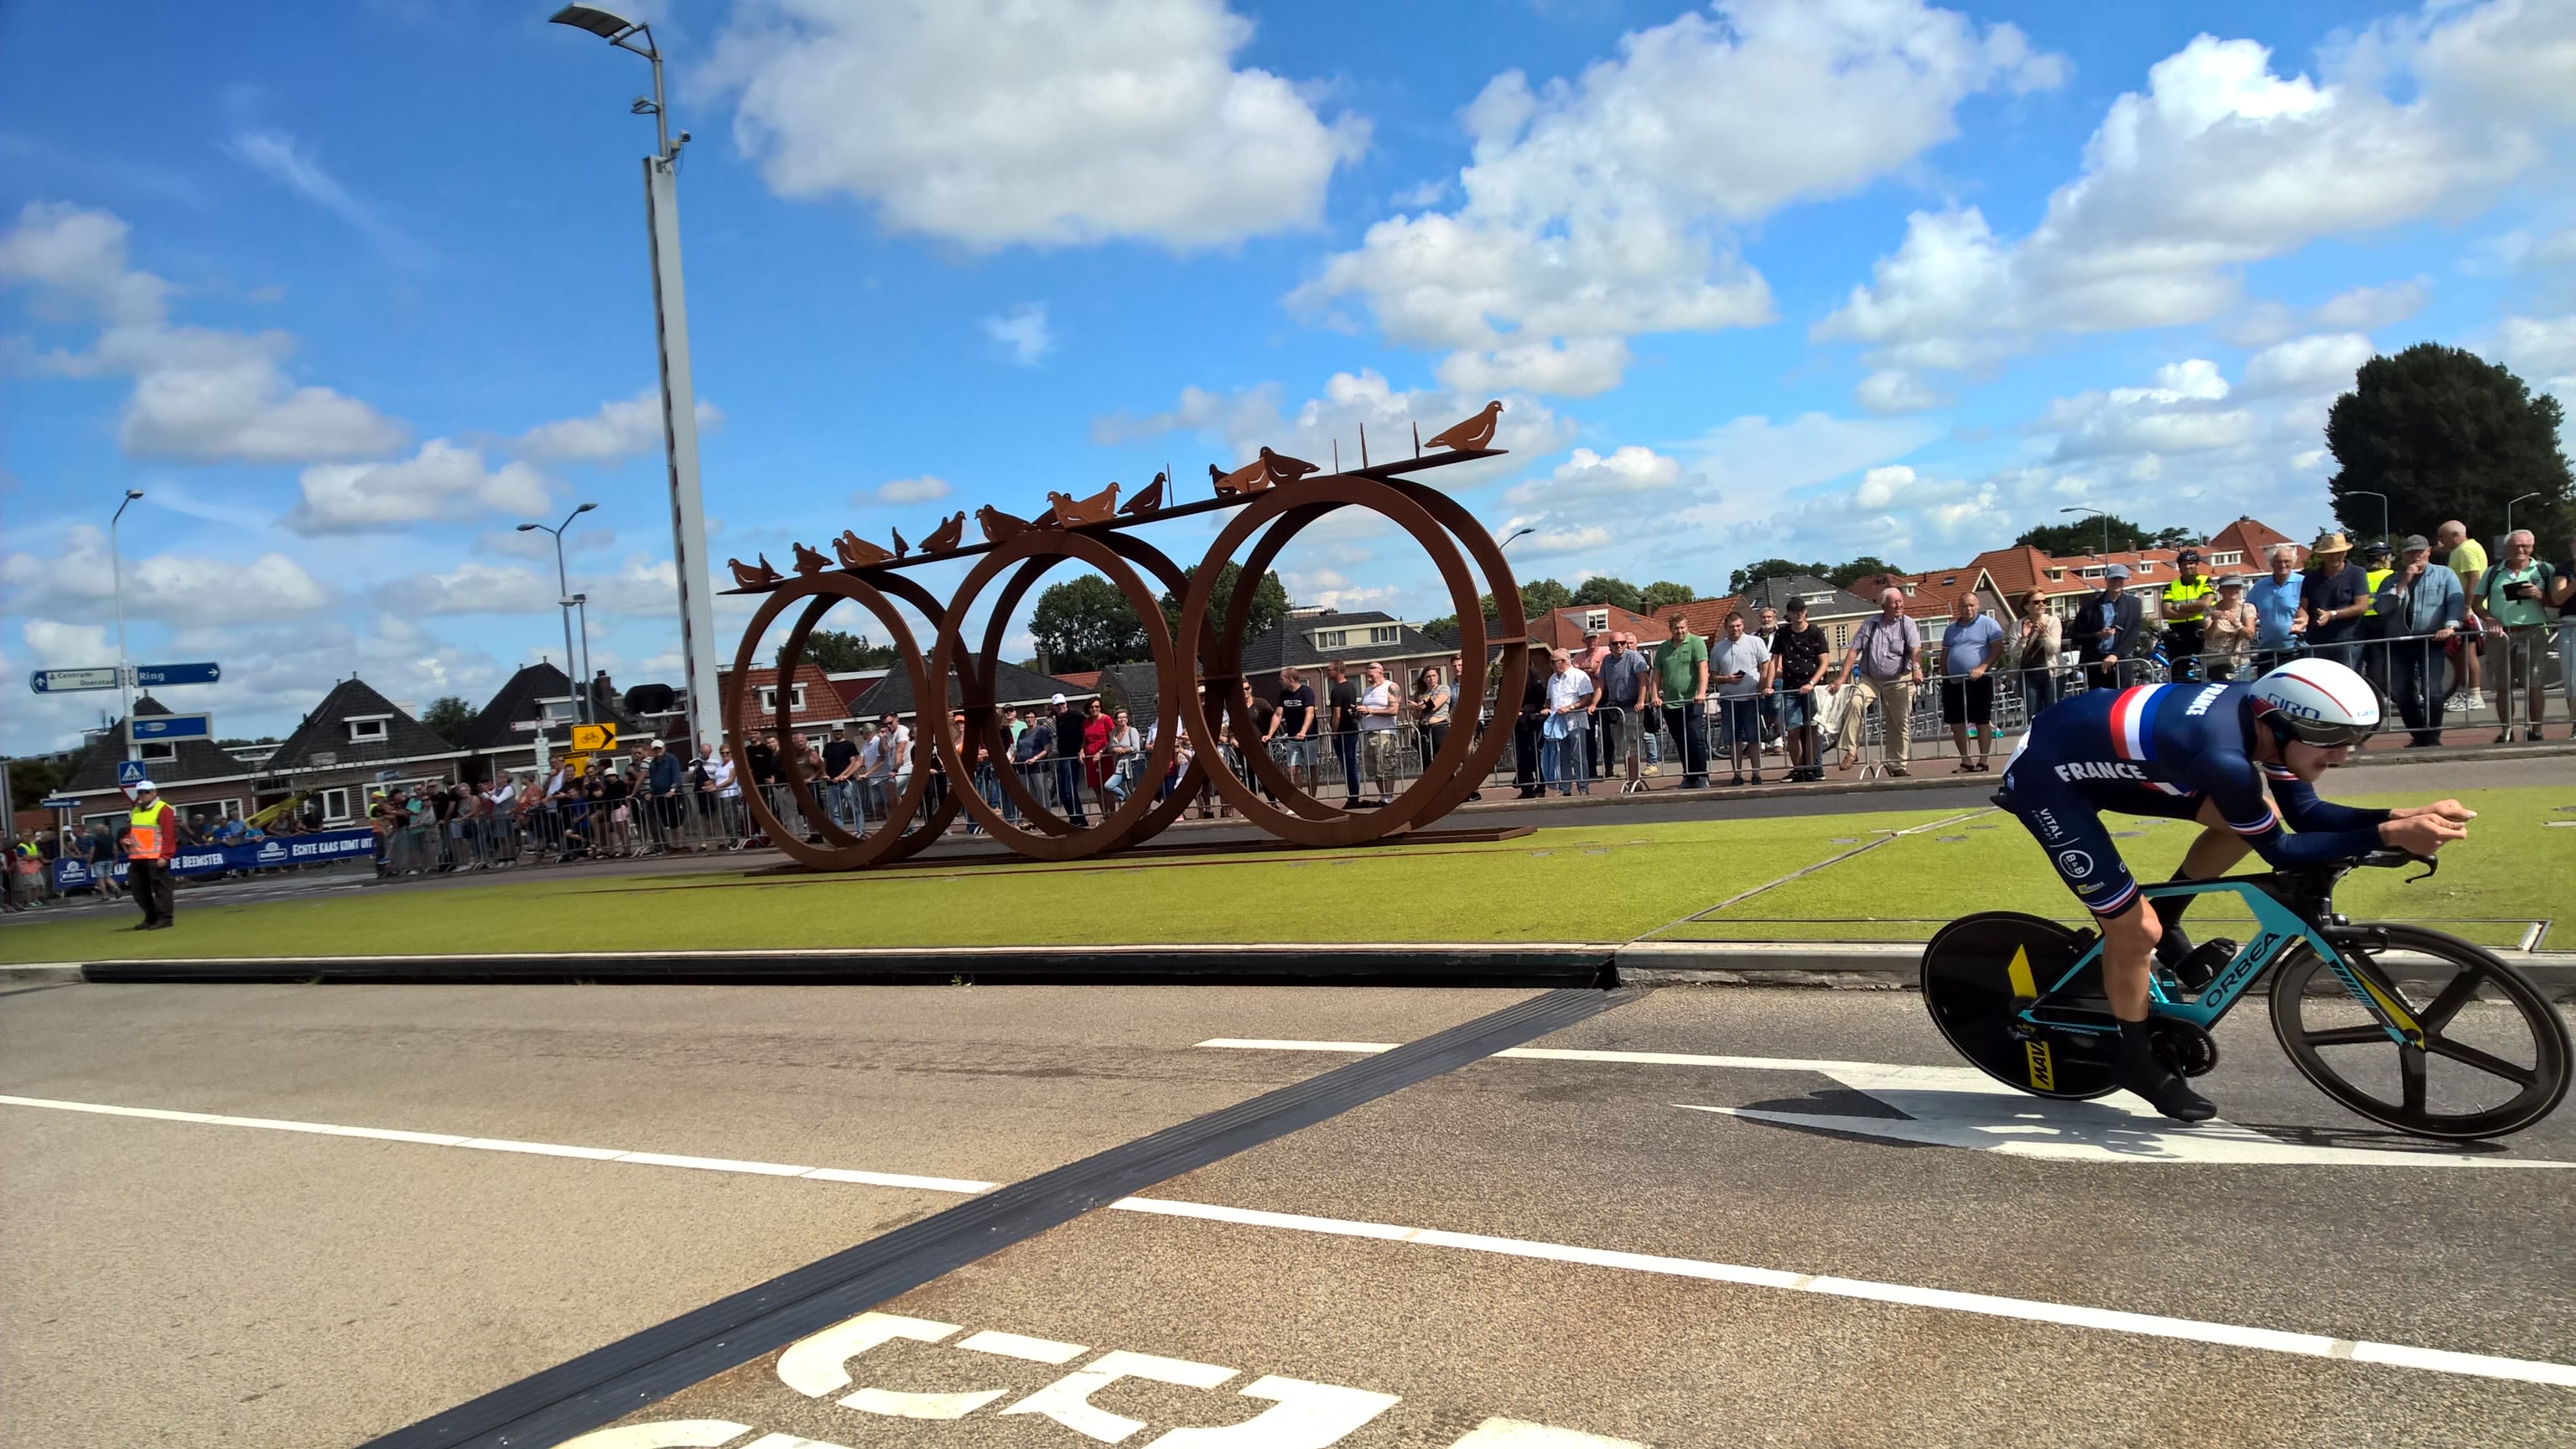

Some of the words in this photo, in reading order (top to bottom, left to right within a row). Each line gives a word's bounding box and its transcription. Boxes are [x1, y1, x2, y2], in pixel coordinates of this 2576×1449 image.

[139, 672, 164, 682] Ring
[2185, 683, 2230, 715] FRANCE
[2054, 761, 2148, 782] FRANCE
[2032, 809, 2055, 841] concept
[2040, 808, 2063, 839] VITAL
[292, 843, 318, 856] ECHTE
[319, 841, 339, 854] KAAS
[340, 839, 360, 852] KOMT
[361, 837, 374, 849] UIT
[170, 856, 181, 870] DE
[182, 853, 224, 869] BEEMSTER
[2065, 854, 2085, 875] B&B
[2205, 932, 2282, 1009] ORBEA
